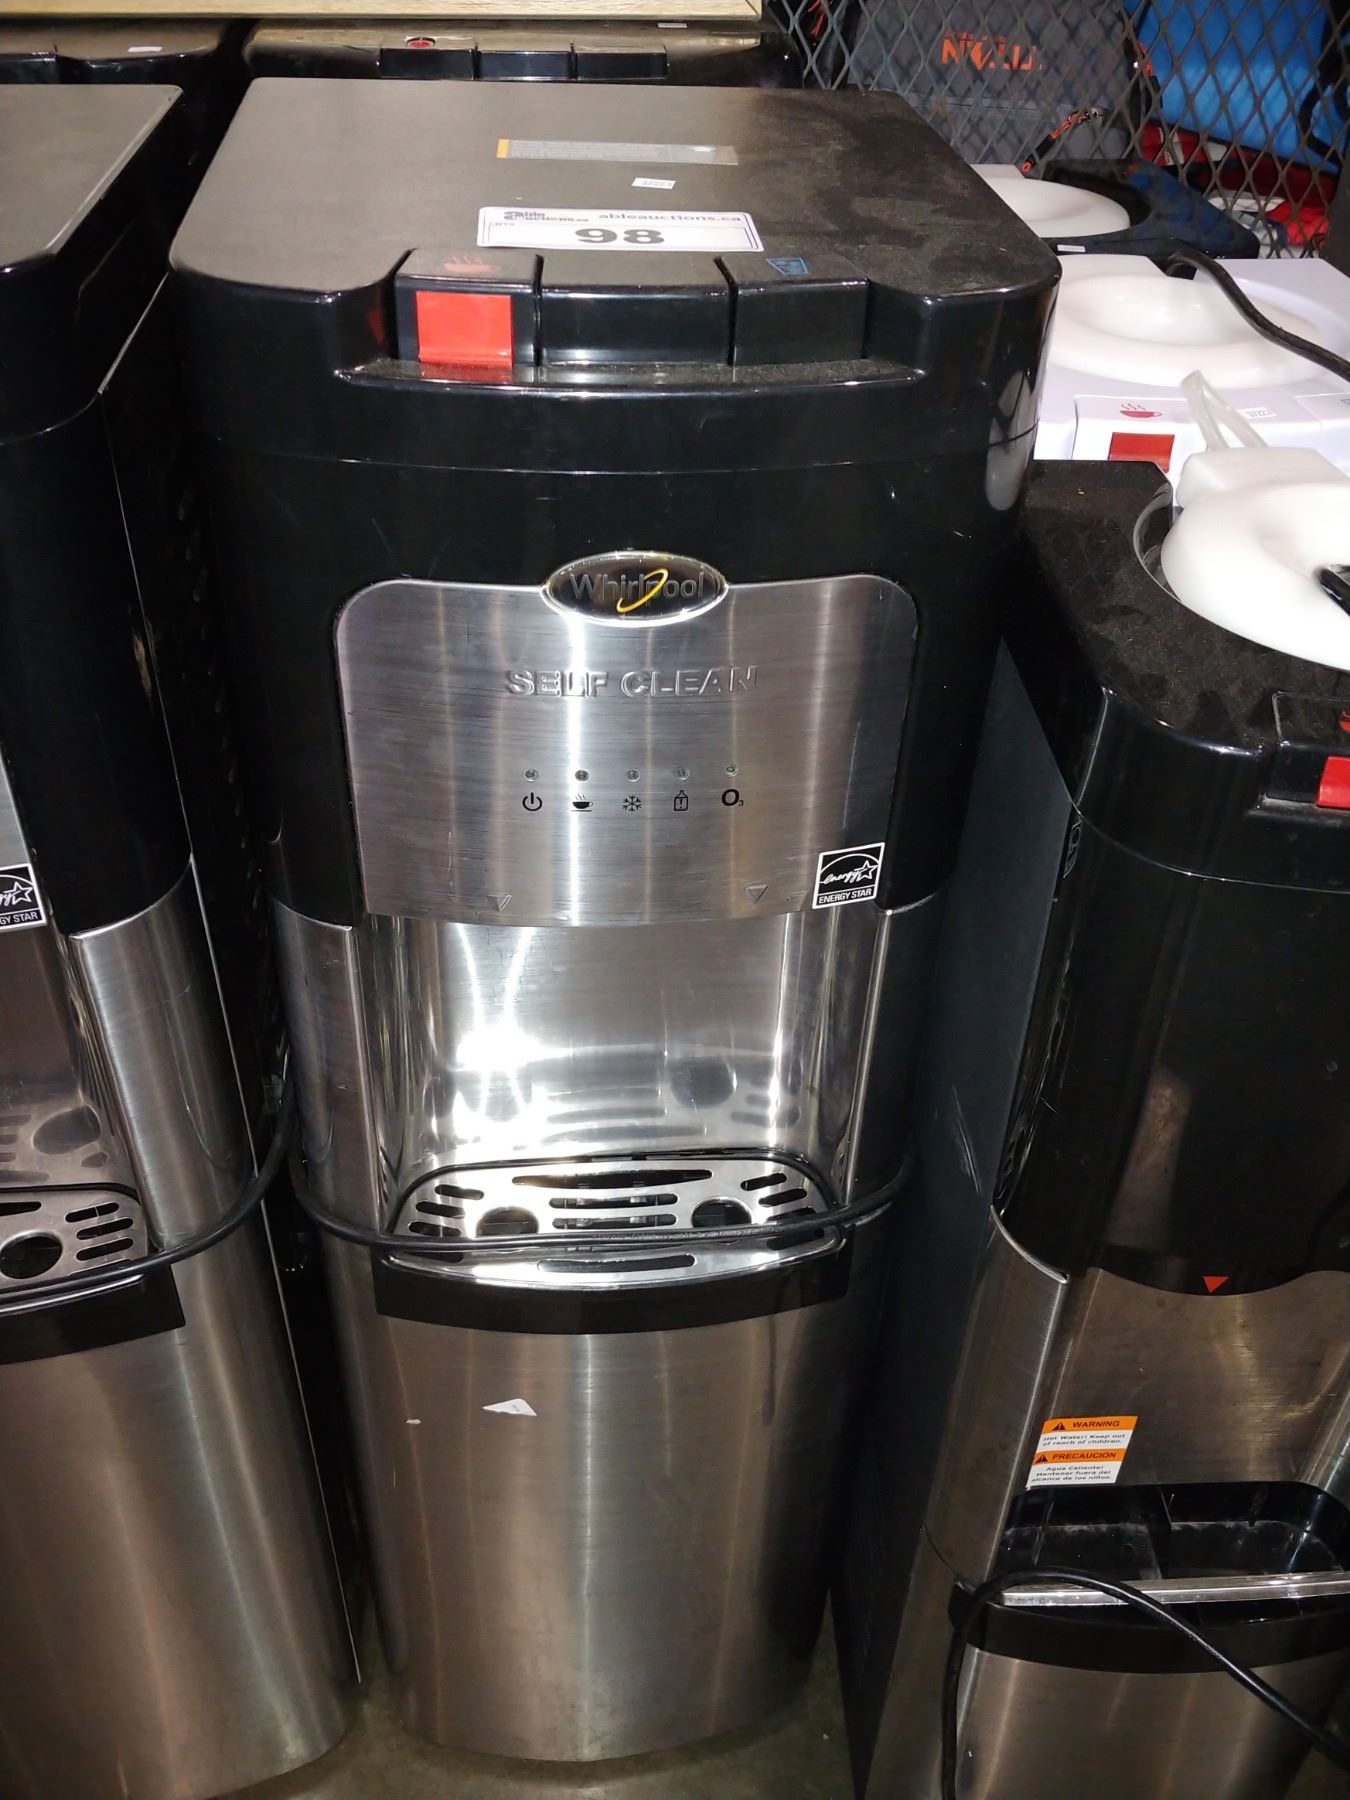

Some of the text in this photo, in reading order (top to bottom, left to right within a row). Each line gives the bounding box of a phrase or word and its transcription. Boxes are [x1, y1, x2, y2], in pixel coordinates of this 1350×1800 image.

[598, 213, 742, 222] ableauctions.ca
[575, 228, 665, 245] 98
[569, 572, 704, 607] Whirlpool
[506, 665, 758, 697] SELF CLEAN
[818, 888, 872, 904] ENERGY STAR
[12, 911, 38, 923] STAR
[1072, 1420, 1121, 1428] WARNING
